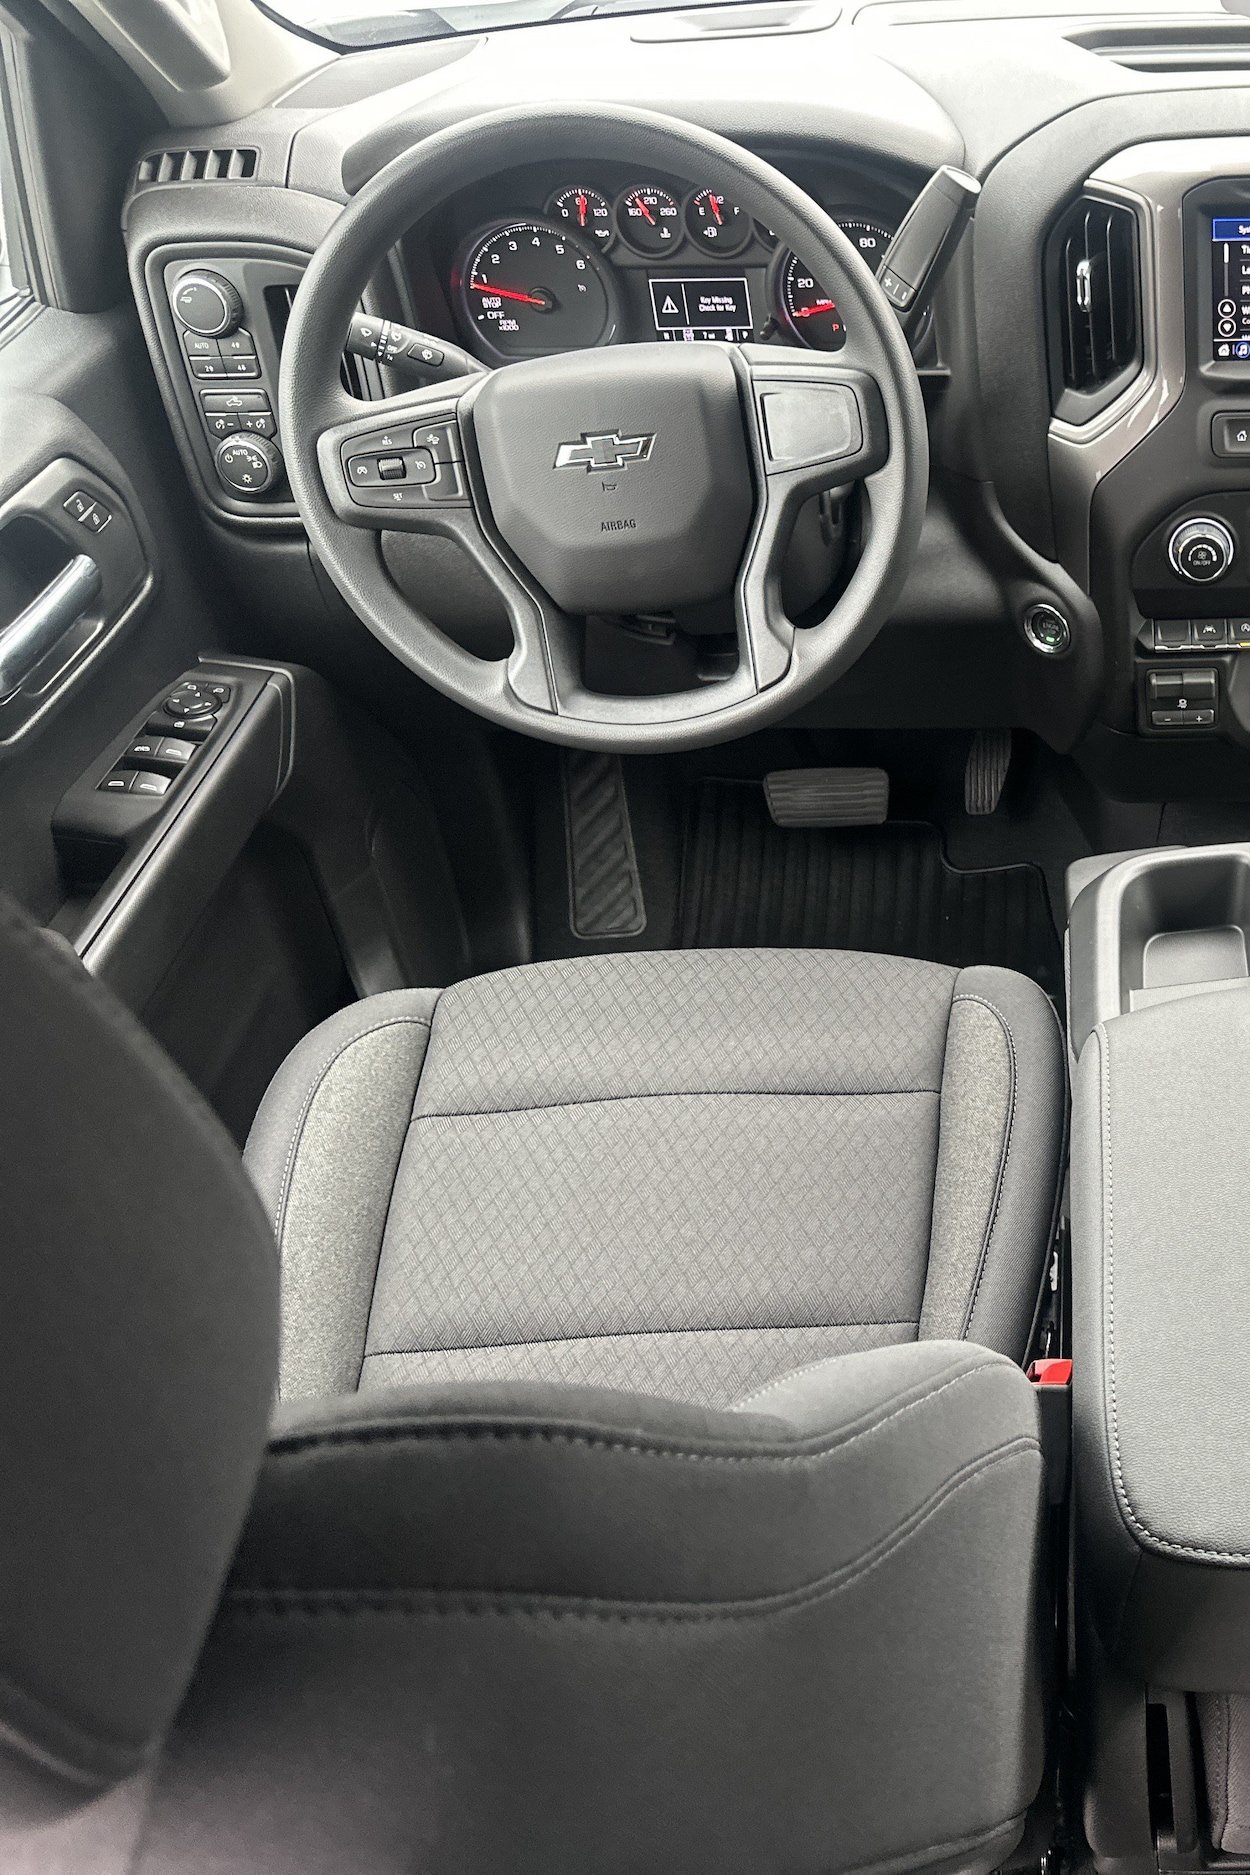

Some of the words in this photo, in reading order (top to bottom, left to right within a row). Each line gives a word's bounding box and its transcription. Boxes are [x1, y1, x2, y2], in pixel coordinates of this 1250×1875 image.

[643, 196, 658, 205] 210
[561, 208, 569, 218] 0
[592, 208, 608, 217] 120
[627, 208, 643, 217] 160
[659, 207, 678, 217] 260
[698, 207, 706, 216] E
[733, 207, 740, 216] F
[508, 241, 518, 251] 3
[531, 237, 541, 247] 4
[859, 238, 876, 248] 80
[555, 244, 565, 254] 5
[491, 254, 500, 264] 2
[576, 260, 586, 270] 6
[481, 273, 488, 284] 1
[797, 278, 814, 288] 20
[481, 296, 502, 304] AUTO
[700, 296, 711, 305] Key
[711, 295, 733, 304] Missing
[699, 304, 716, 312] Check
[725, 304, 736, 313] Key
[486, 311, 505, 320] OFF
[832, 323, 840, 332] P
[601, 518, 637, 532] AIRBAG
